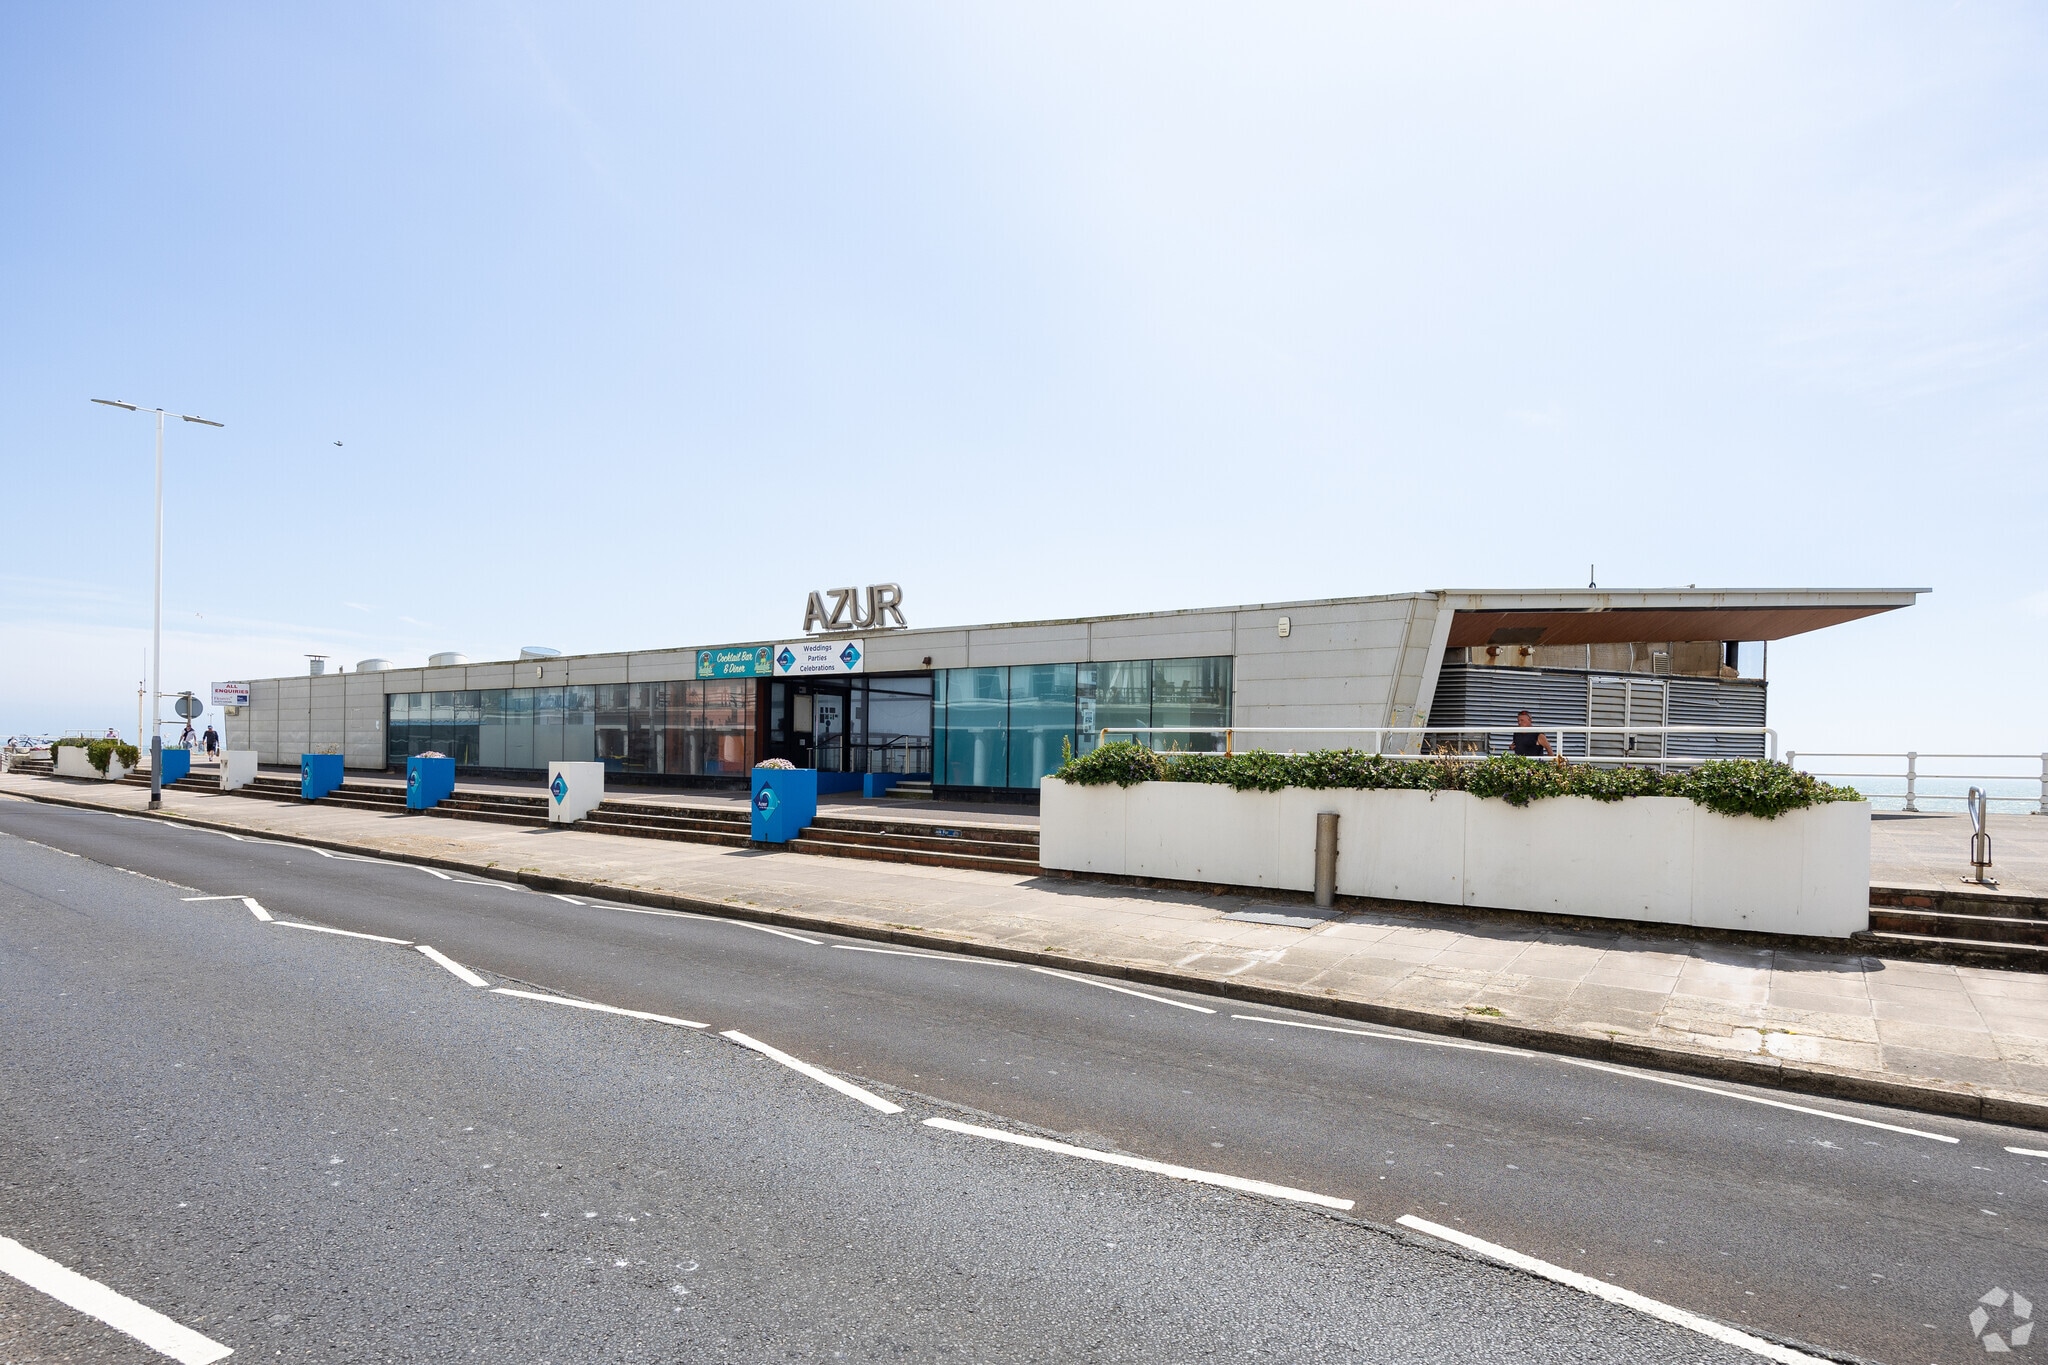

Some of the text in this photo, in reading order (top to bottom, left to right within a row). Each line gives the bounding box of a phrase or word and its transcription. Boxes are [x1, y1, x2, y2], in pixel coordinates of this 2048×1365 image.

[803, 584, 907, 631] AZUR
[717, 651, 753, 662] Cocktail Bar
[724, 664, 729, 674] &
[729, 664, 745, 673] Diner
